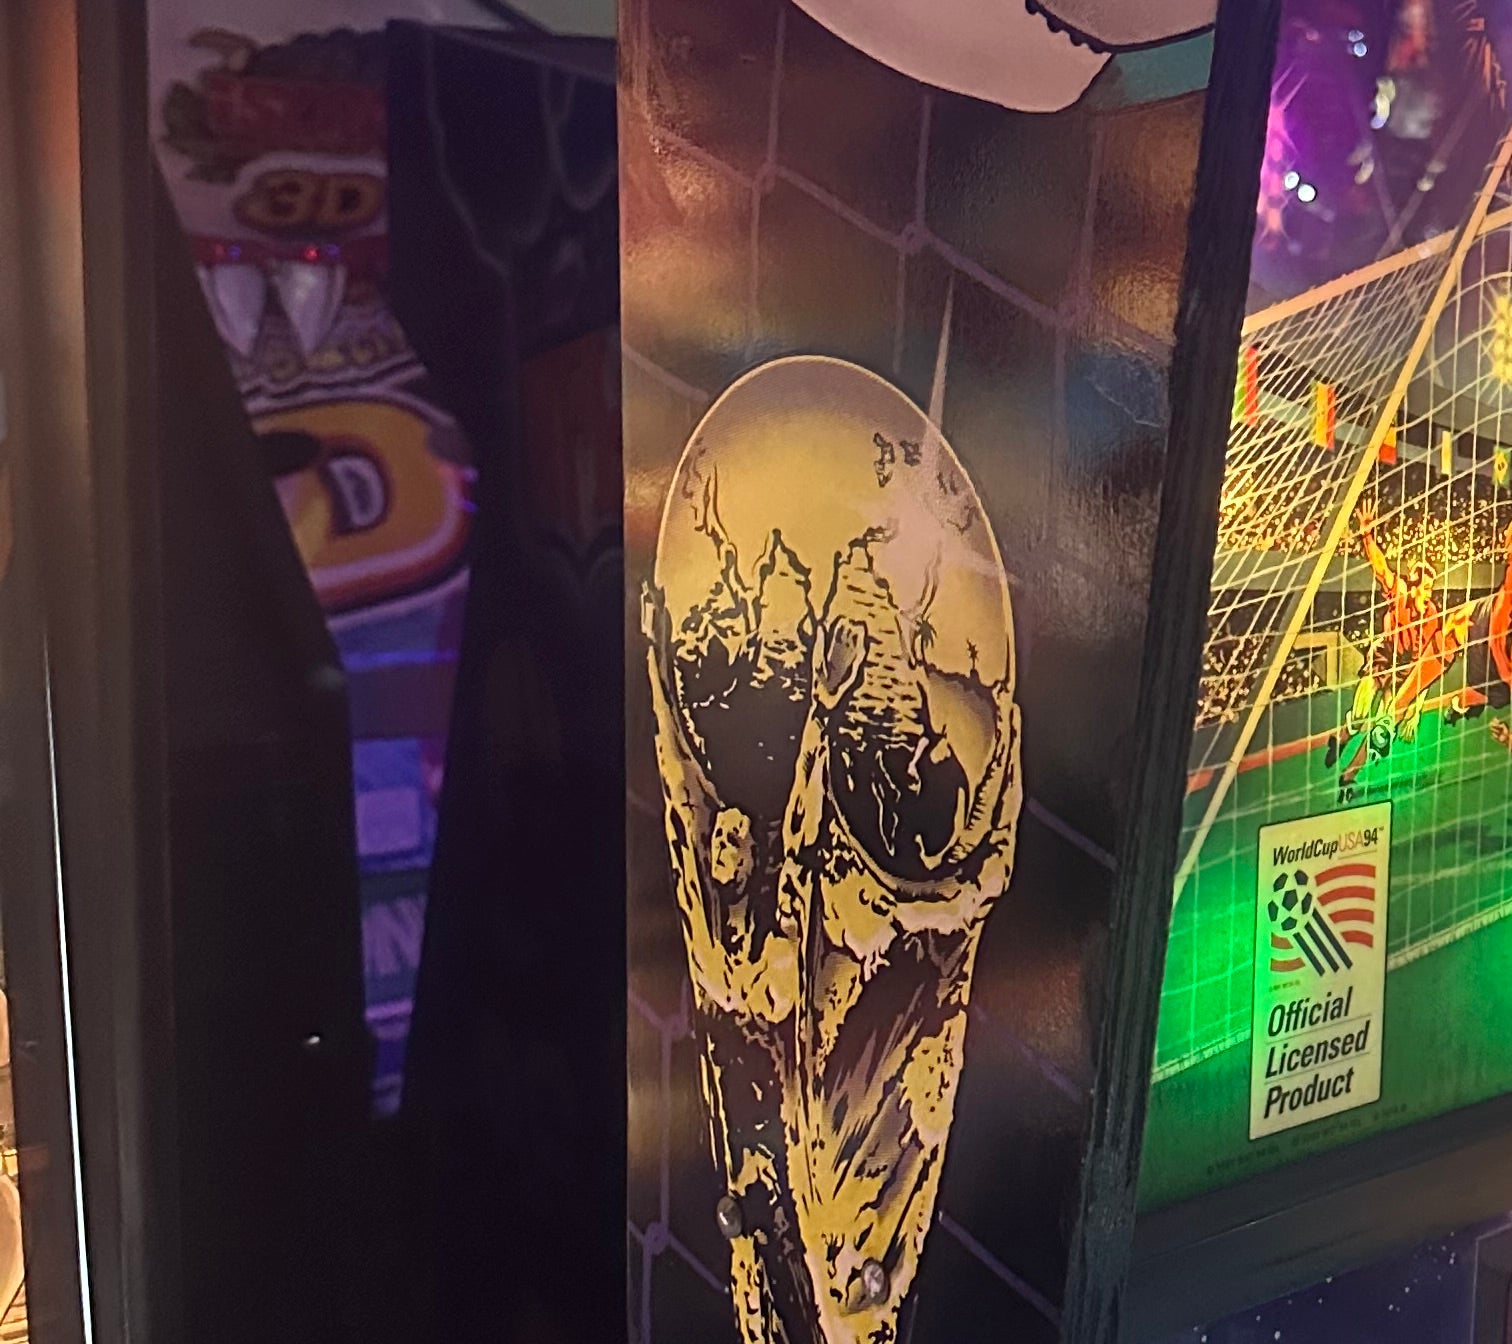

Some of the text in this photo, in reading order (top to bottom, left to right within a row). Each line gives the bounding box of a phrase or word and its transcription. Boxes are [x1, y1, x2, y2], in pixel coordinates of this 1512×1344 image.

[1268, 986, 1353, 1037] Official
[1265, 1021, 1371, 1079] Licensed
[1264, 1066, 1355, 1119] Product
